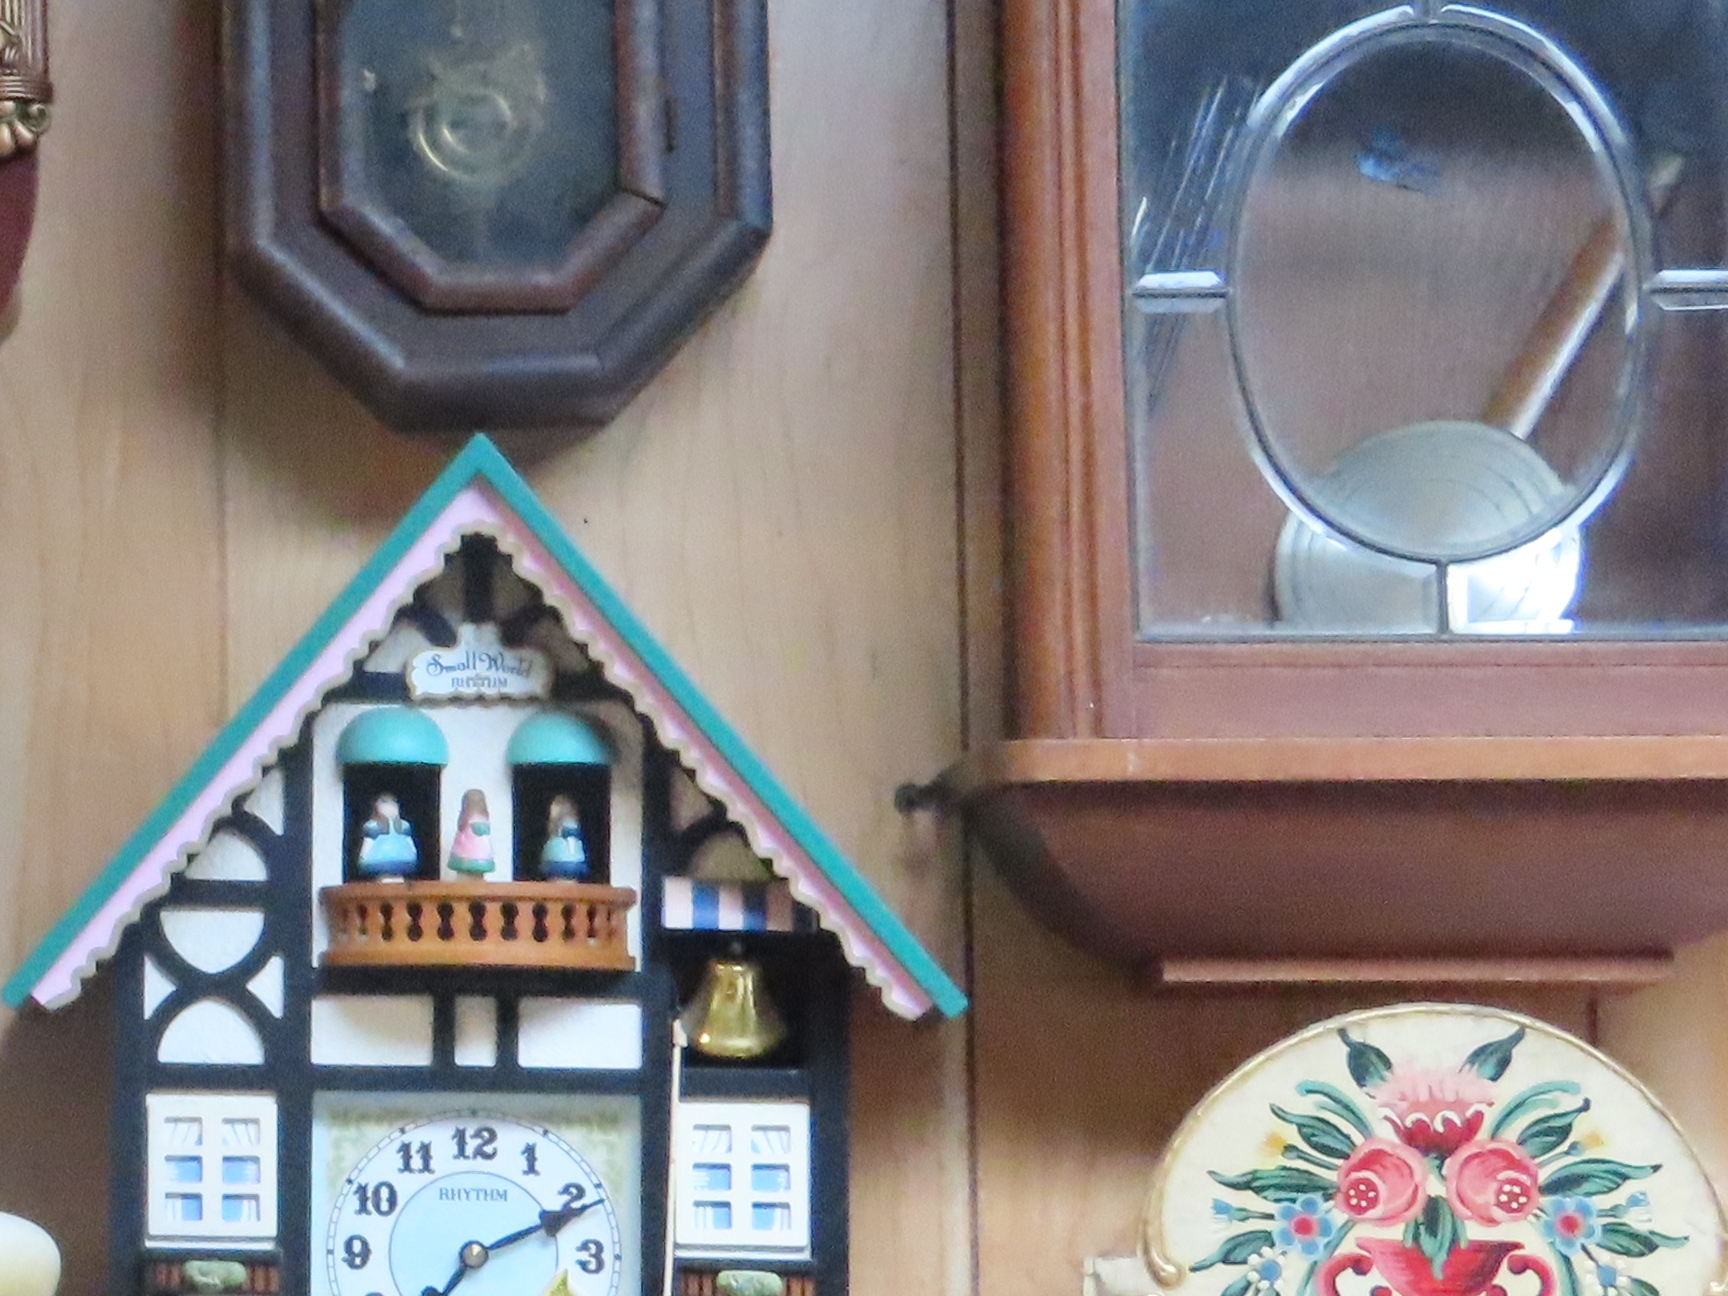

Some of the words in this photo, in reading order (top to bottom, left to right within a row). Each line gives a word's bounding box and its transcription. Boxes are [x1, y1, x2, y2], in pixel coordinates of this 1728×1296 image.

[426, 651, 476, 676] Small
[396, 1141, 436, 1174] 11
[451, 1126, 498, 1160] 12
[521, 1142, 541, 1176] 1
[352, 1181, 398, 1216] 10
[439, 1187, 508, 1203] RHYTHM
[342, 1234, 372, 1270] 9
[575, 1239, 605, 1274] 3
